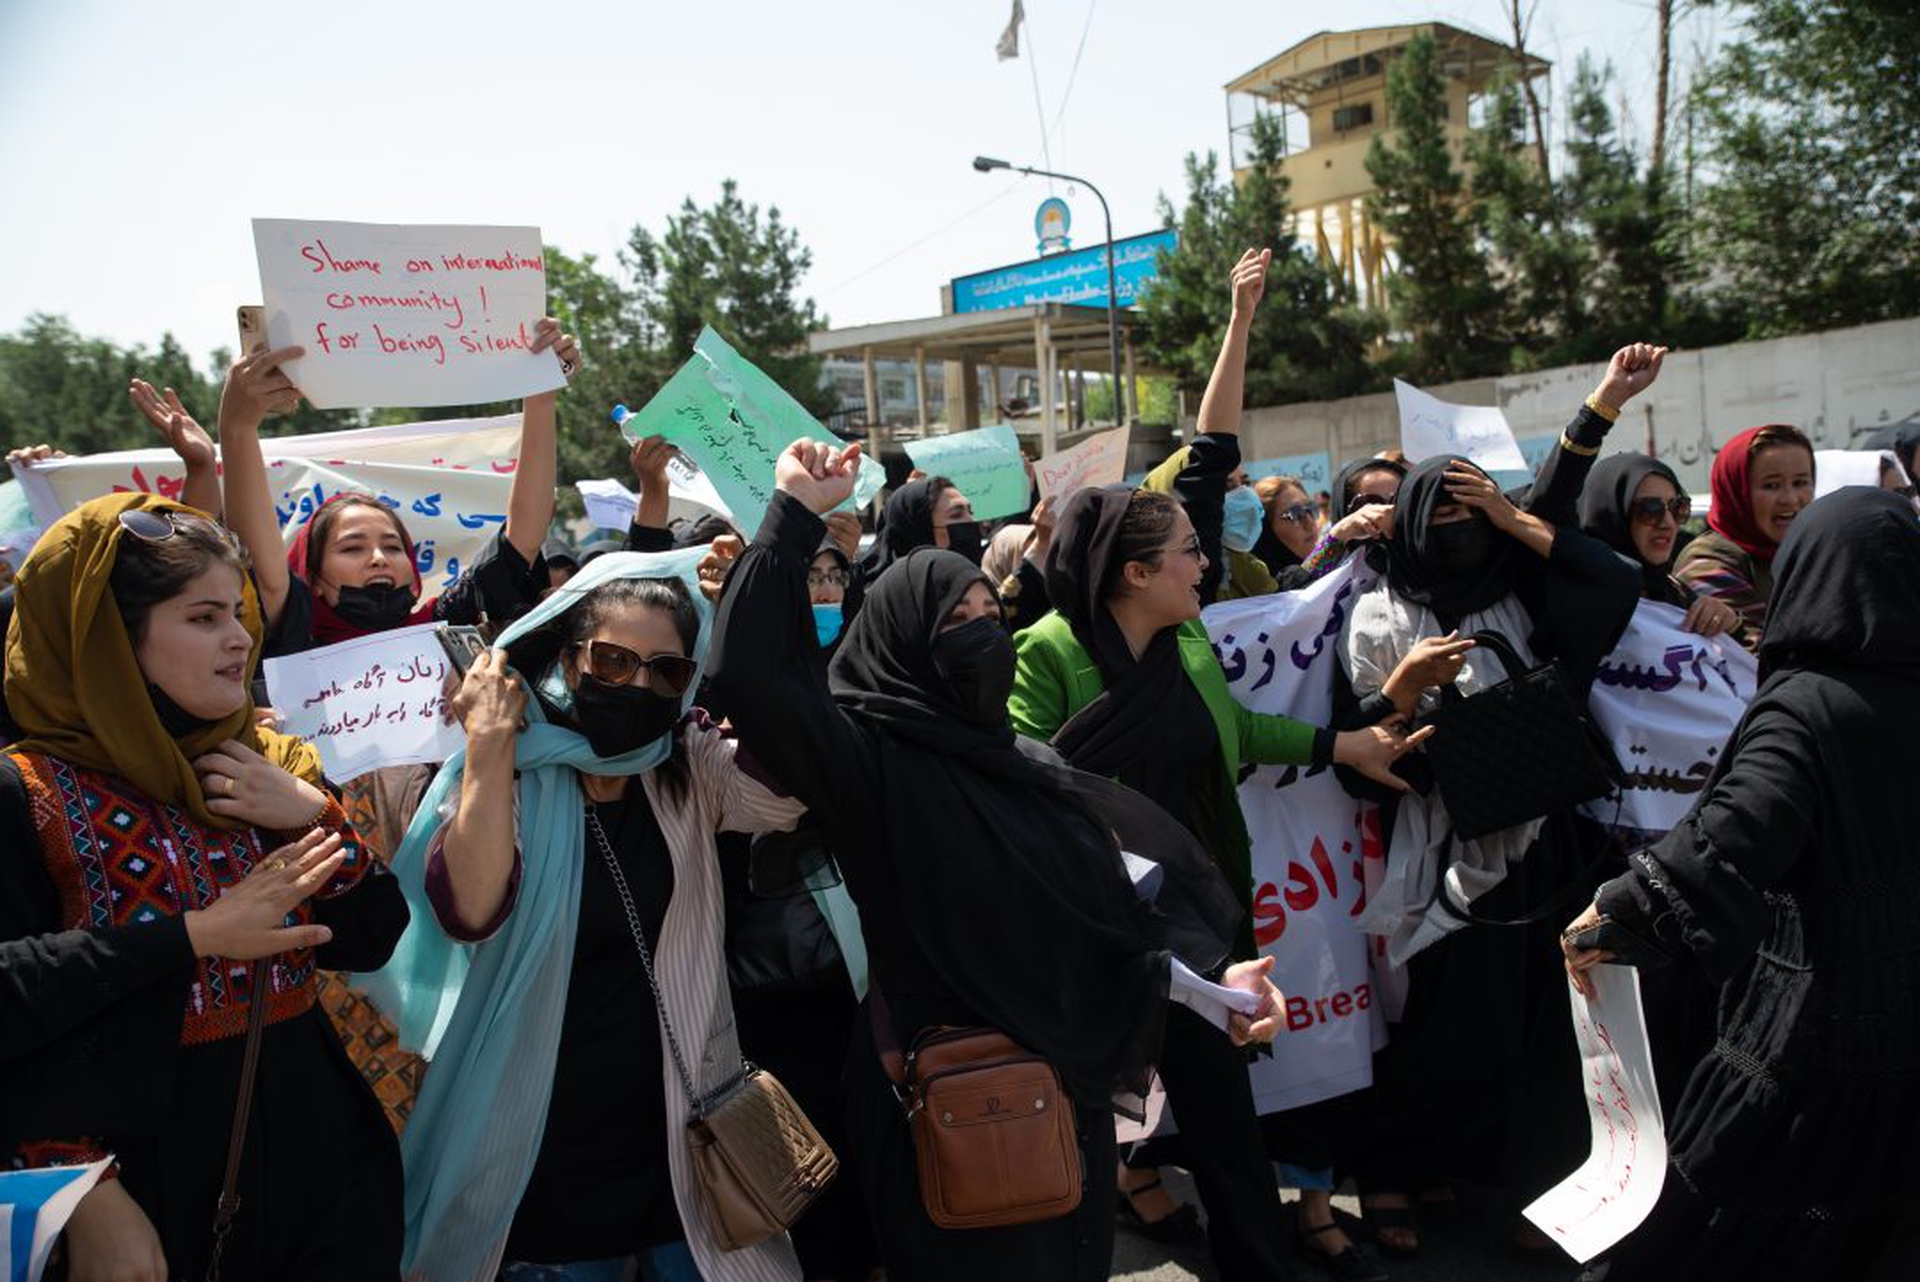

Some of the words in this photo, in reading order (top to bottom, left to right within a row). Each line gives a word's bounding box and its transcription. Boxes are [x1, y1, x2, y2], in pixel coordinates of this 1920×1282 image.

[301, 239, 382, 275] Shame
[406, 259, 434, 273] on
[326, 288, 463, 329] community
[316, 321, 359, 354] for
[372, 323, 445, 364] being
[411, 492, 443, 517] که
[353, 663, 387, 689] آگاه
[397, 653, 446, 683] زنان
[1252, 834, 1367, 948] زادی
[1284, 982, 1371, 1033] Brea
